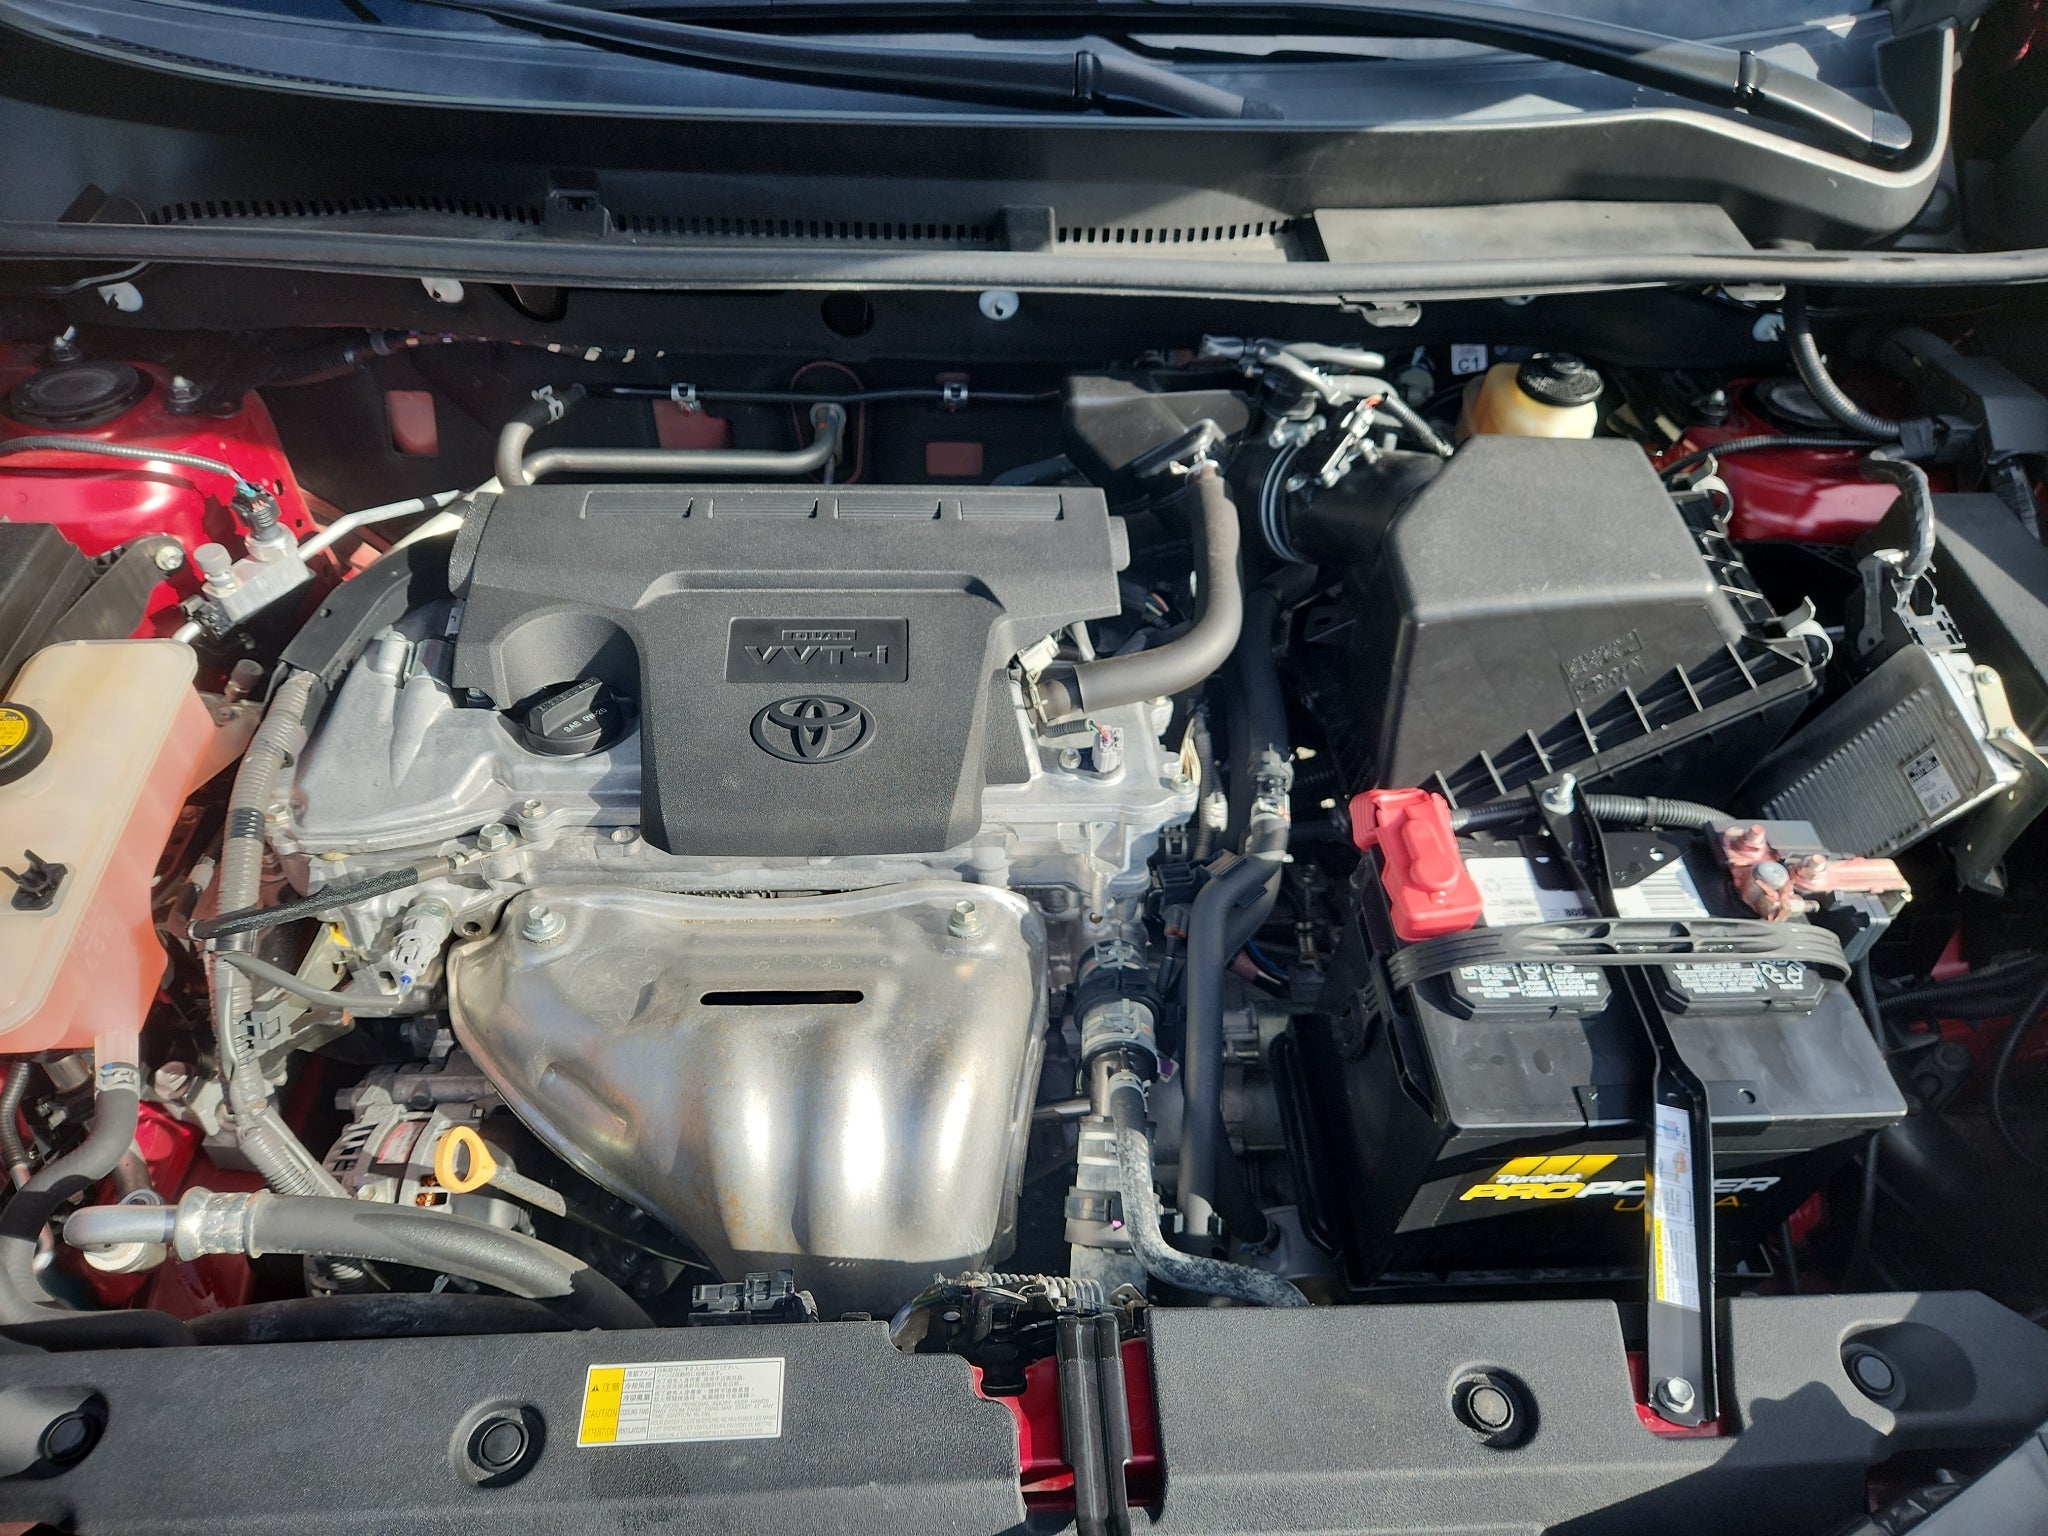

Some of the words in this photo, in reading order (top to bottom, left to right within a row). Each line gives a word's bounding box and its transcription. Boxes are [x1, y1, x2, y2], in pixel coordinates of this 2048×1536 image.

[1458, 357, 1479, 373] C1
[791, 631, 851, 641] DUAL
[745, 645, 888, 664] VVT-i
[563, 720, 582, 733] SAE
[582, 707, 608, 722] 0W-20
[1495, 1172, 1583, 1184] Duralast
[1459, 1176, 1781, 1201] PROPOER
[585, 1408, 618, 1419] CAUTION
[583, 1427, 615, 1438] ATTENTION
